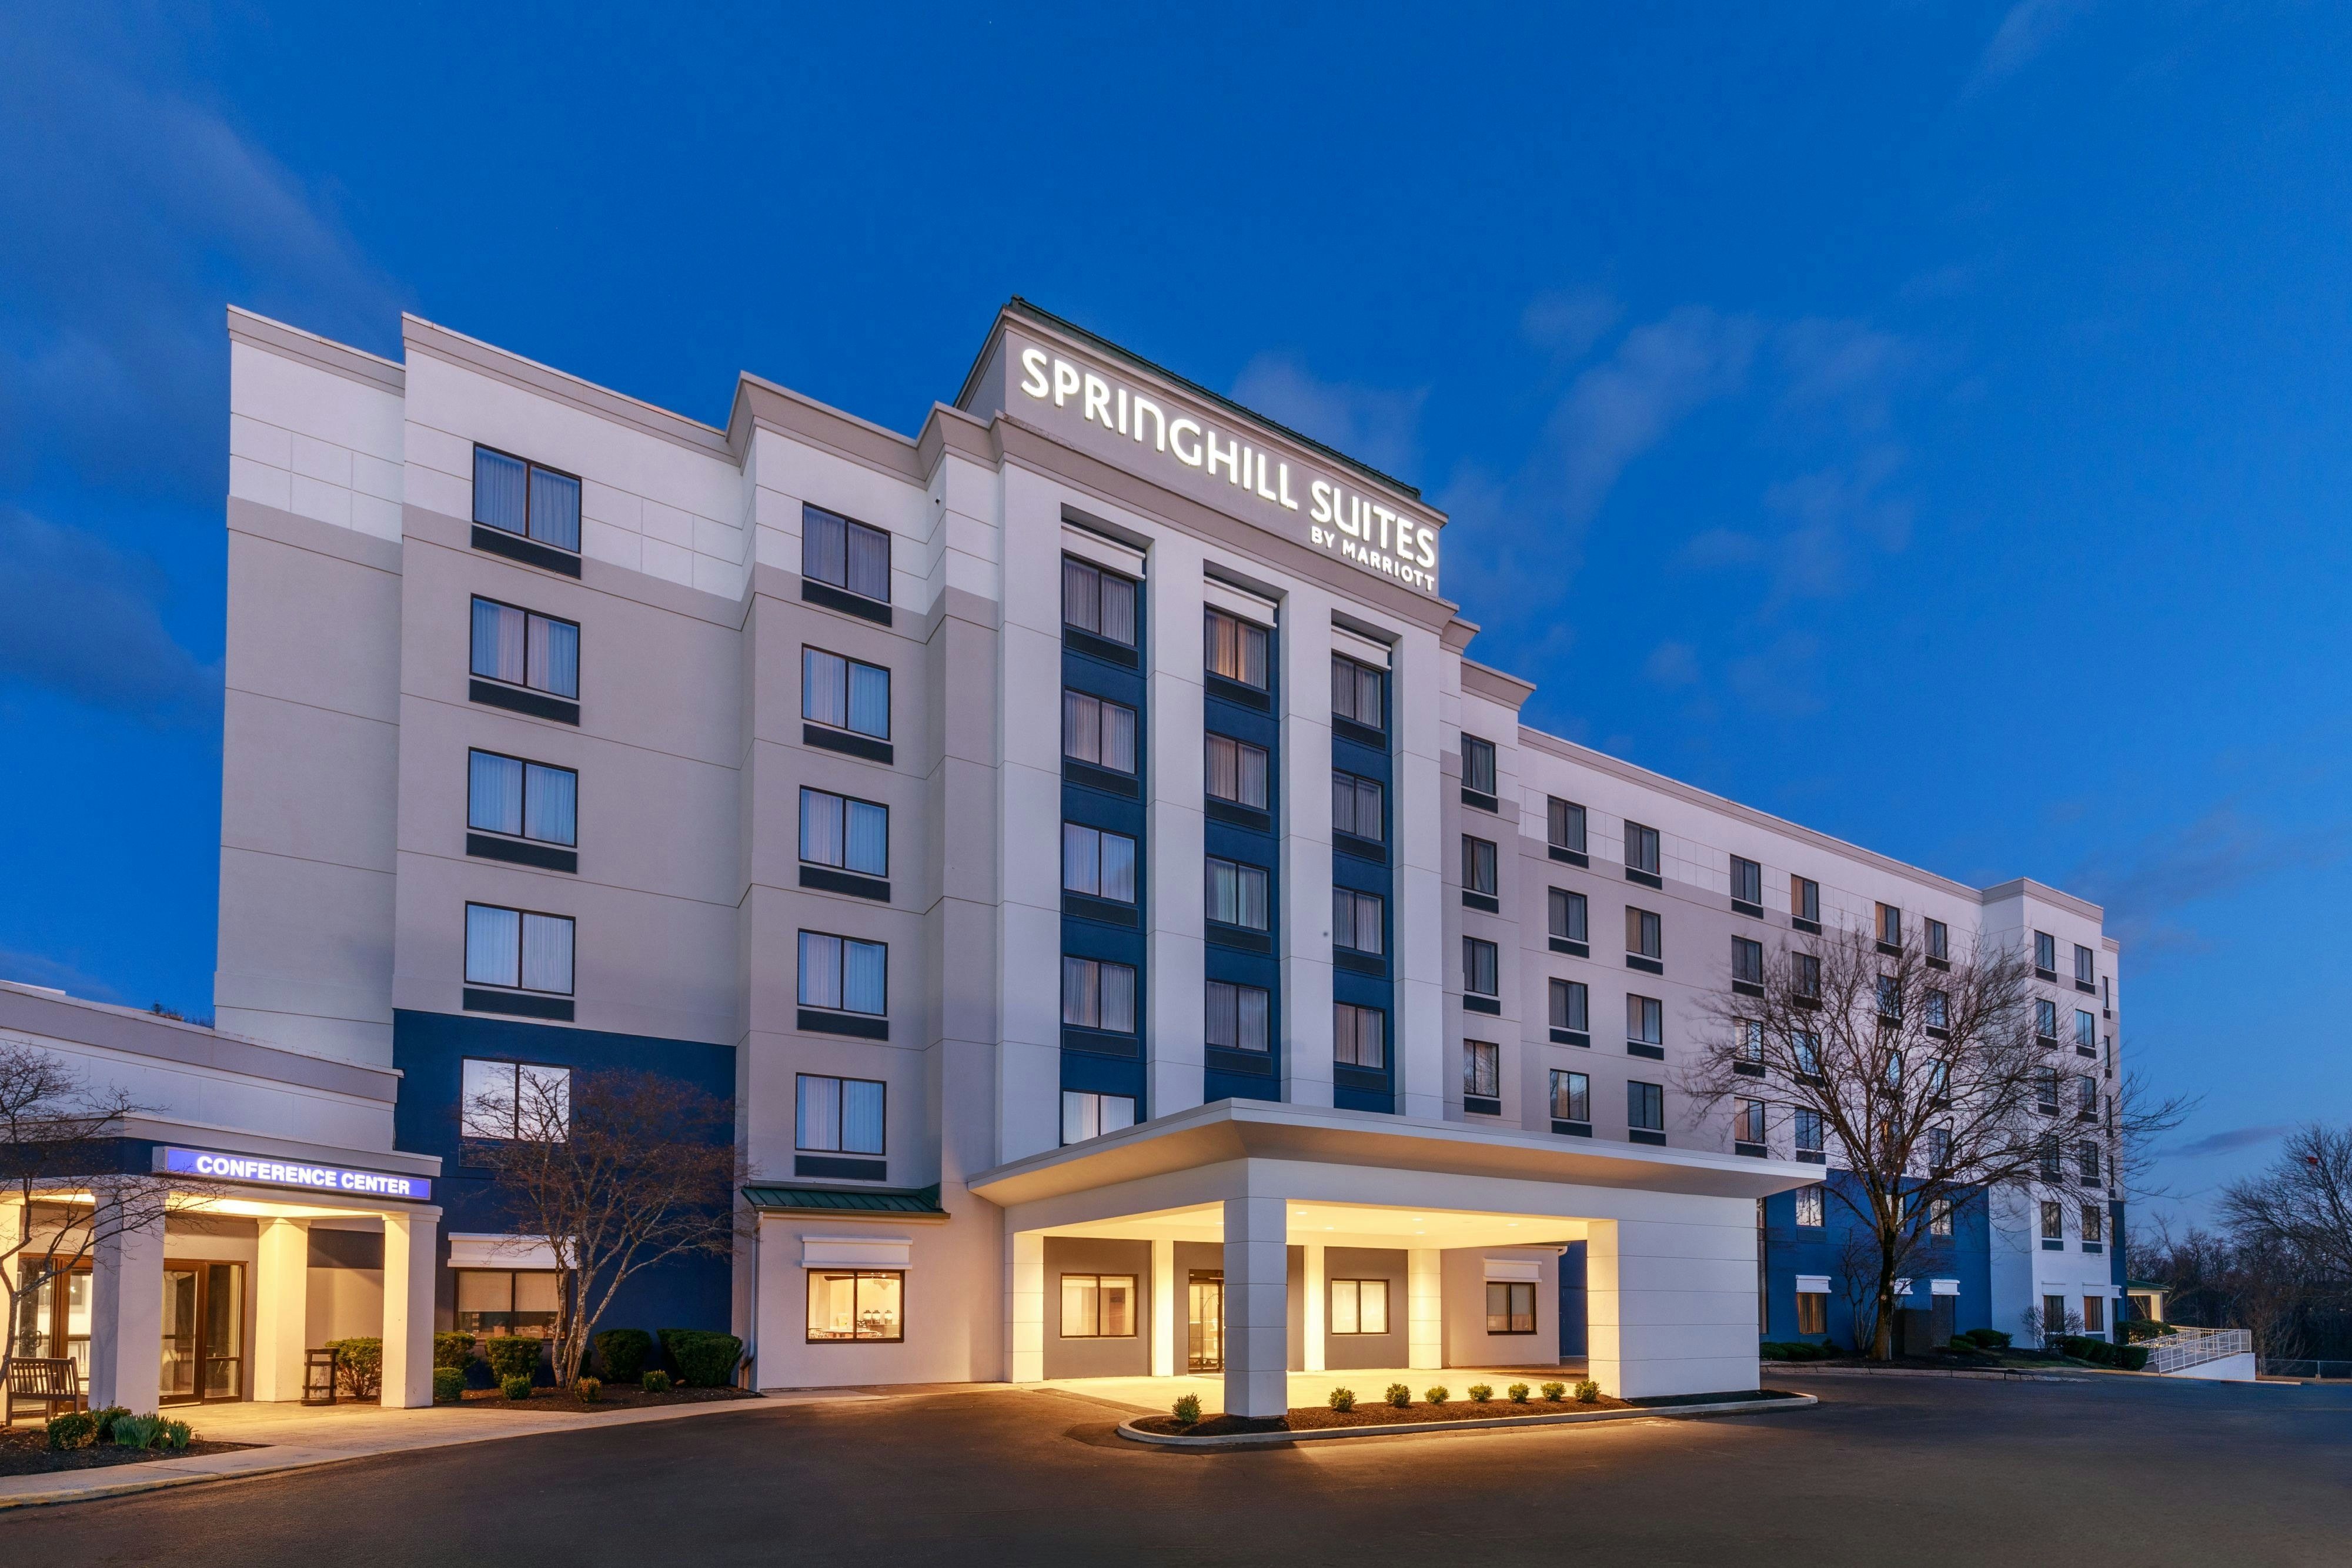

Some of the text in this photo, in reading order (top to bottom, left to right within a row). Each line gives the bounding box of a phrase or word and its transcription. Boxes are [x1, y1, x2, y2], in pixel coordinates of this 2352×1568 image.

[1020, 347, 1435, 569] SPRINGHILL SUITES
[1311, 525, 1435, 591] BY MARRIOTT
[196, 1155, 410, 1195] CONFERENCE CENTER
